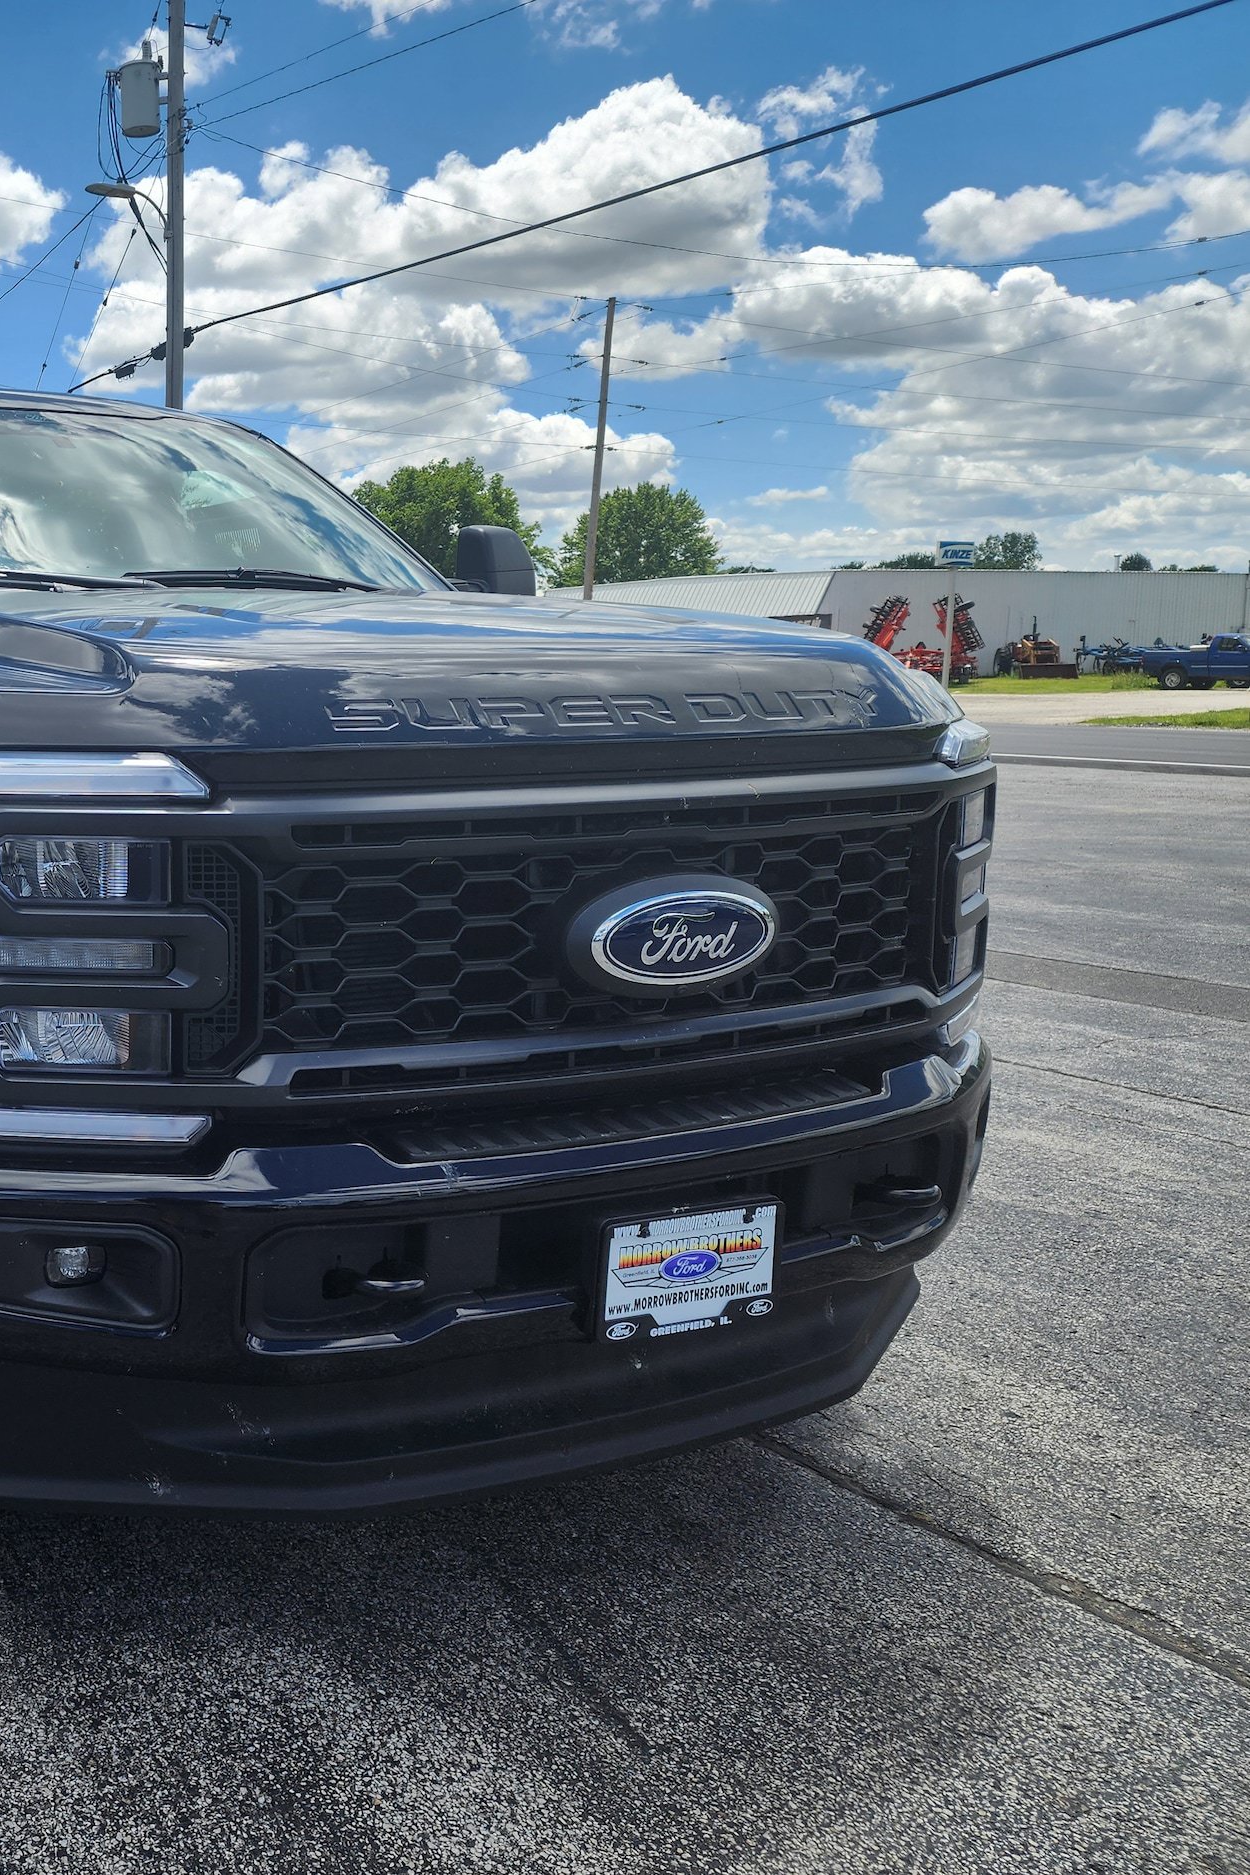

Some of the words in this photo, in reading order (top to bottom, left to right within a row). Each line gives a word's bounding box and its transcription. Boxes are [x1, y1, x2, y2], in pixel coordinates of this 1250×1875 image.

[941, 549, 974, 560] KINZE
[326, 694, 676, 732] SUPER
[683, 687, 879, 724] DUTY
[640, 911, 739, 966] Ford
[672, 1255, 707, 1277] Ford
[751, 1301, 769, 1314] Ford
[611, 1324, 631, 1338] Ford
